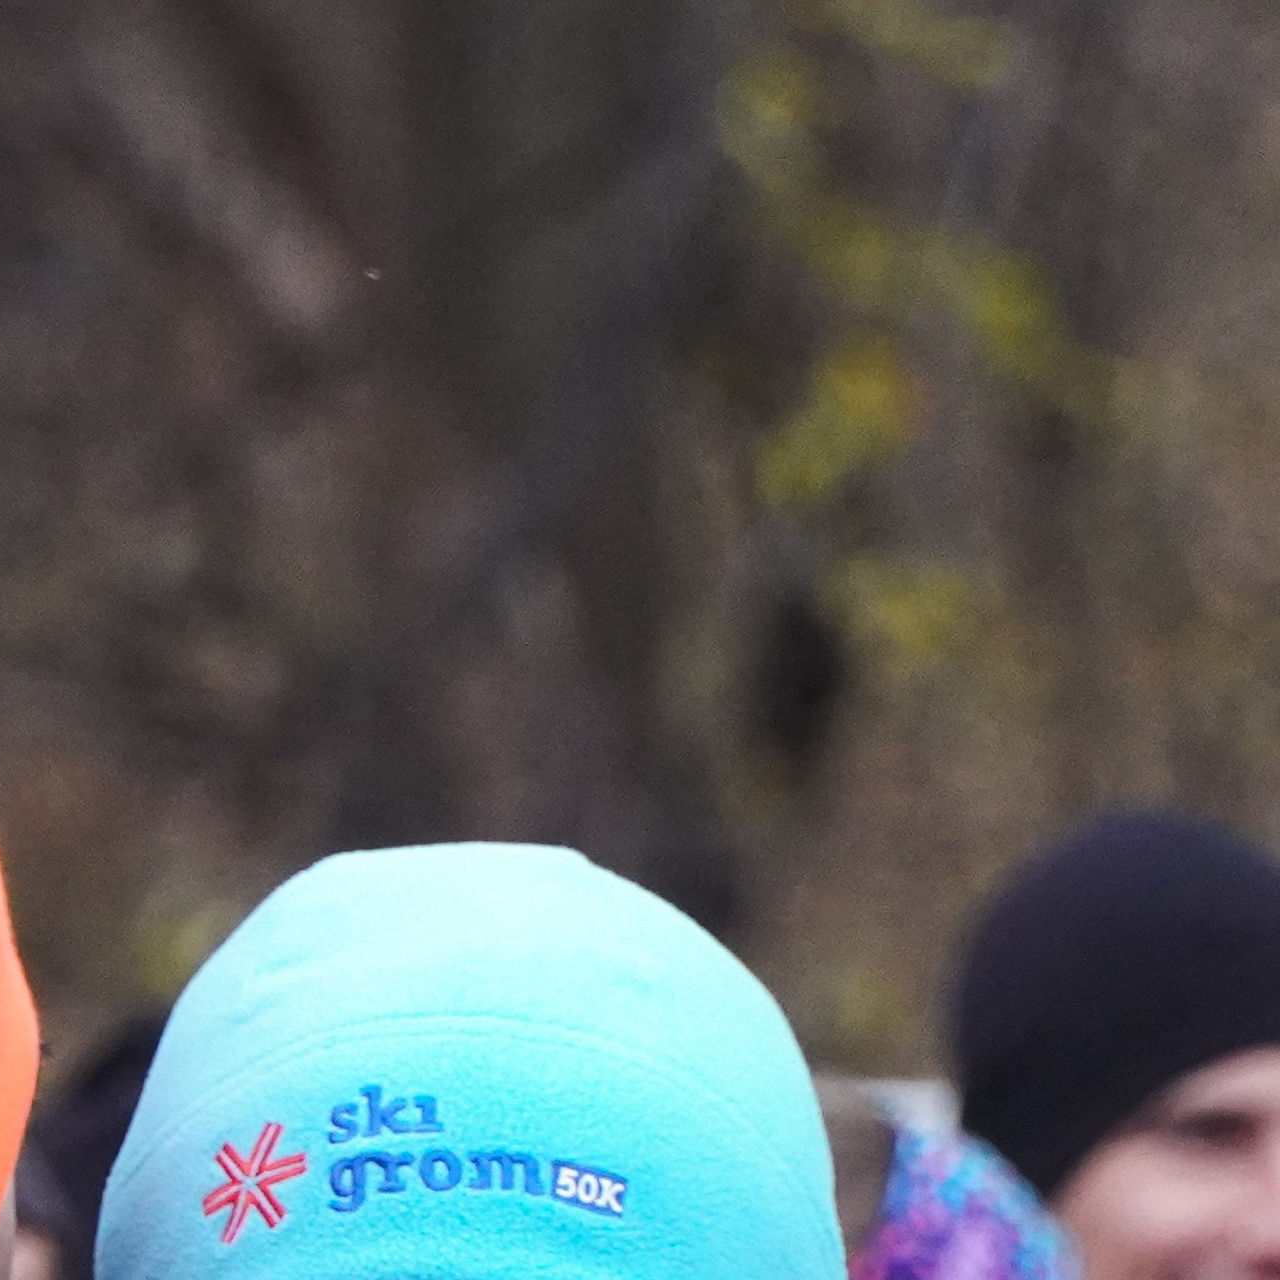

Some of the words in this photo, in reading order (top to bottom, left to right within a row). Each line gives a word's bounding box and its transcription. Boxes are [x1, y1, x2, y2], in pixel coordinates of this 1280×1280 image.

[328, 1084, 444, 1144] ski
[328, 1149, 544, 1212] grom
[554, 1168, 626, 1214] 50K
